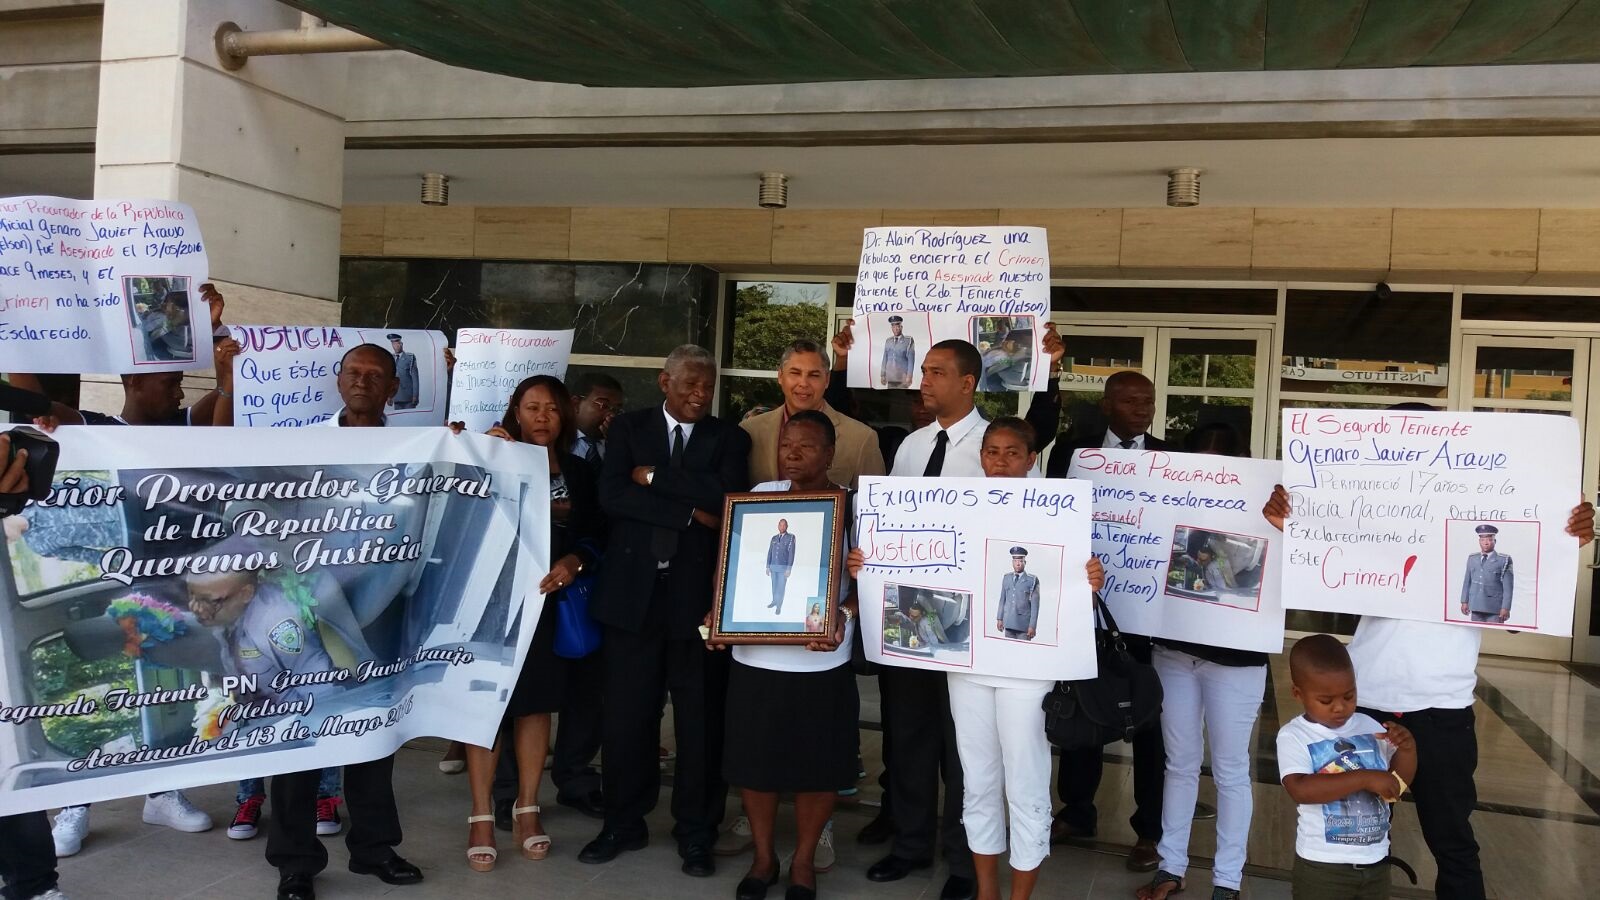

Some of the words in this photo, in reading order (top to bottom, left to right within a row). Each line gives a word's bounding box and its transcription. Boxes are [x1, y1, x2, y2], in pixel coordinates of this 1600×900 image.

[91, 207, 104, 221] de
[107, 207, 118, 221] la
[864, 232, 881, 249] Dr.
[885, 230, 914, 246] Alain
[1003, 232, 1031, 245] una
[24, 260, 37, 280] 9
[82, 272, 89, 284] y
[0, 293, 49, 312] rimen
[56, 295, 72, 307] no
[75, 294, 88, 307] ha
[94, 295, 120, 307] sido
[243, 393, 264, 408] no
[26, 477, 125, 507] eñor
[136, 468, 358, 512] Procurador
[365, 467, 492, 504] General
[1409, 470, 1438, 495] 17
[1433, 480, 1468, 493] años
[1499, 478, 1516, 495] la
[1022, 487, 1079, 516] Haga
[143, 514, 182, 542] de
[191, 513, 226, 539] la
[232, 505, 396, 541] Republica
[862, 519, 952, 562] Justicia
[100, 546, 282, 586] Queremos
[292, 535, 423, 574] Justicia
[0, 693, 98, 725] egundo
[105, 684, 208, 711] Teniente
[222, 674, 258, 697] PN
[269, 668, 351, 693] Genaro
[217, 693, 315, 728] (Nelson)
[66, 736, 210, 773] Acecinado
[214, 728, 239, 751] el
[245, 726, 276, 748] 13
[280, 720, 310, 743] de
[312, 714, 383, 738] Mayo
